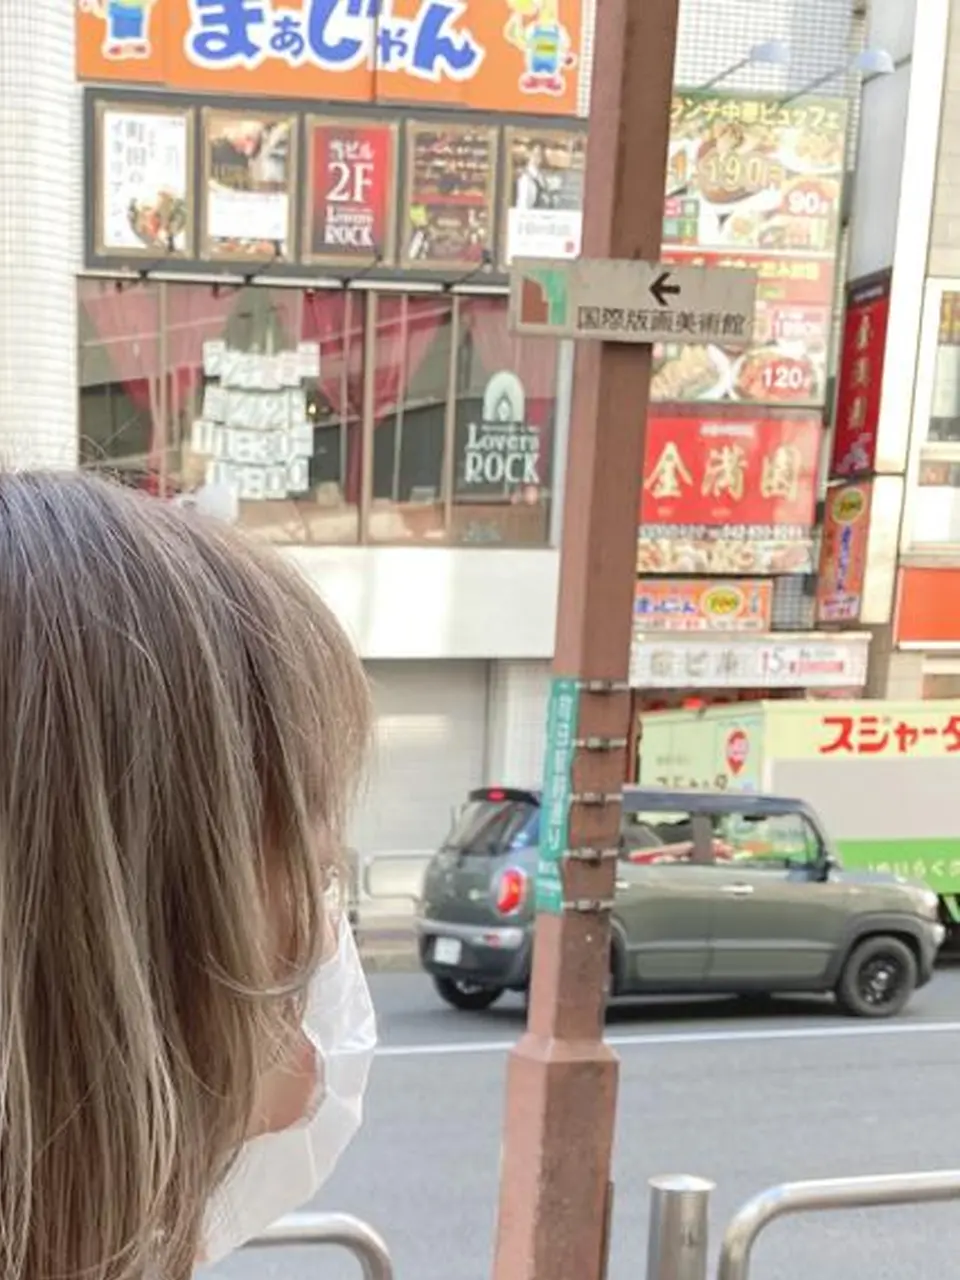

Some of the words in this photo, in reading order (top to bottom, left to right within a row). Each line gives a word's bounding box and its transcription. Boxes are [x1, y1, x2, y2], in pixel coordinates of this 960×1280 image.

[188, 0, 480, 74] まぁじゃん
[325, 162, 374, 203] 2F
[324, 223, 374, 247] ROCK
[577, 305, 746, 335] 国際版画美術館
[465, 423, 541, 451] Lovers
[465, 451, 541, 483] ROCK
